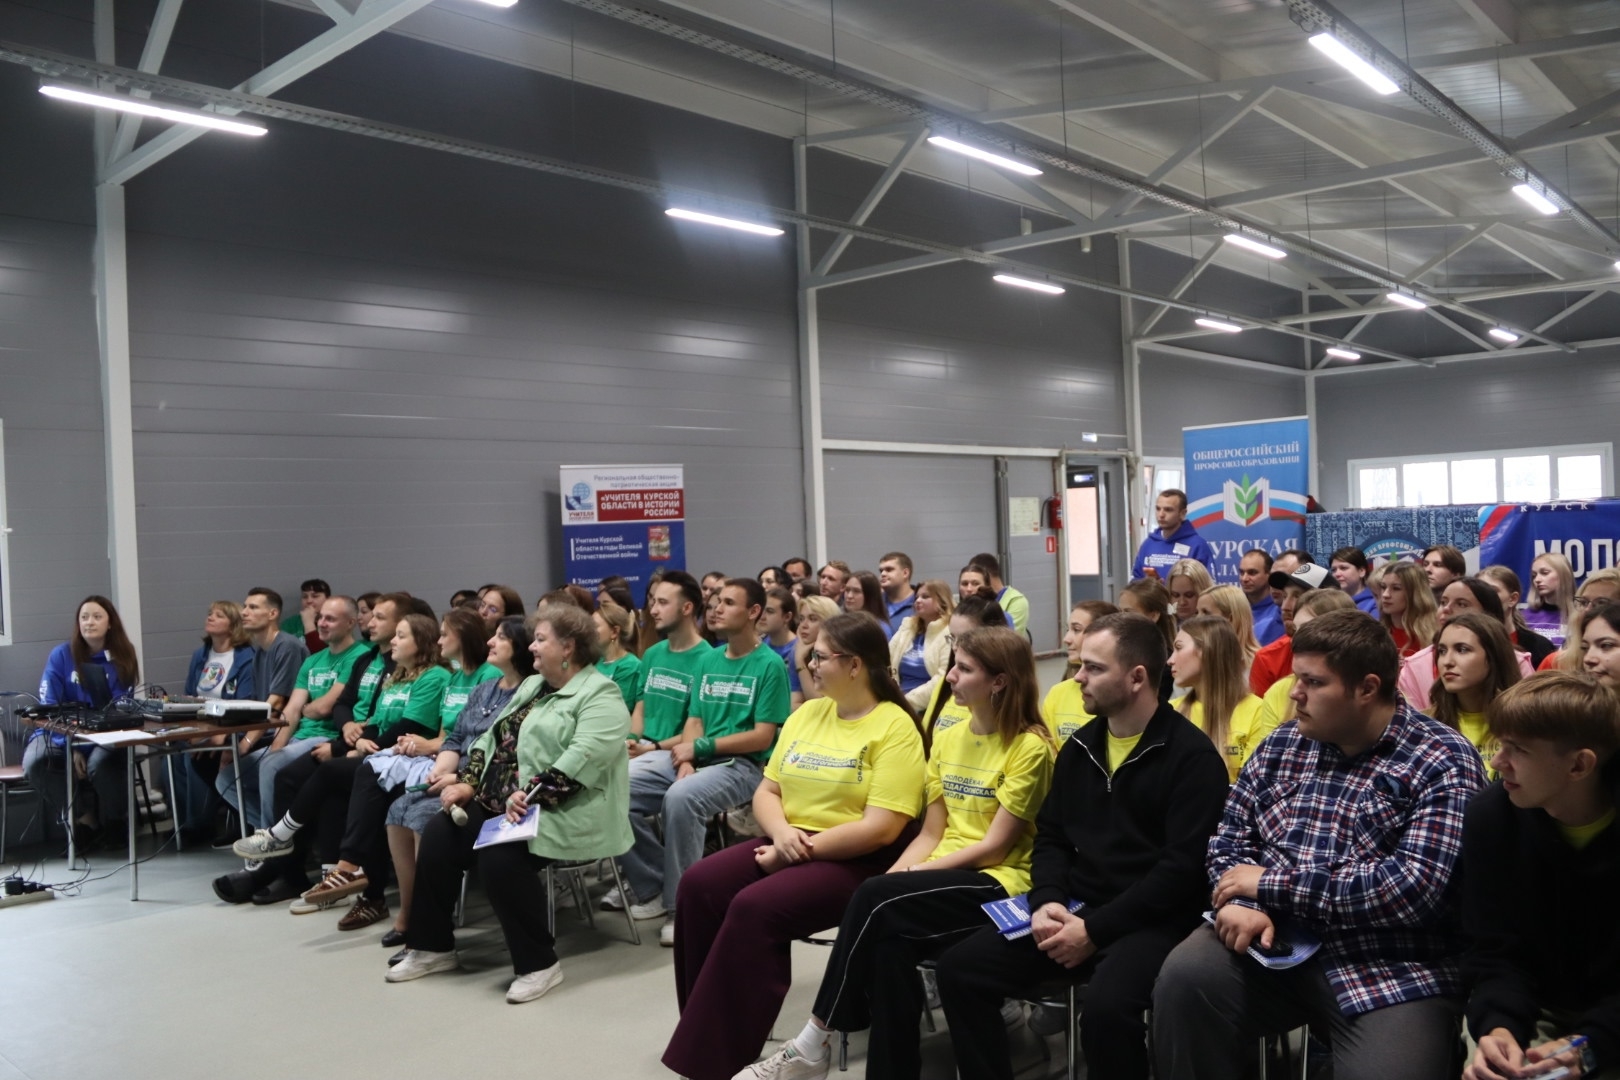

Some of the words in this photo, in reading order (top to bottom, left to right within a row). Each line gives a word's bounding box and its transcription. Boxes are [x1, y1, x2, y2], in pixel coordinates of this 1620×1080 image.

[1192, 441, 1300, 461] ОБЩЕРОССИЙСКИЙ
[1194, 460, 1241, 471] ПРОФСОЮЗ
[1241, 456, 1300, 467] ОБРАЗОВАНИЯ
[600, 493, 641, 502] «УЧИТЕЛЯ
[643, 491, 680, 500] КУРСКОЙ
[600, 501, 637, 510] ОБЛАСТИ
[638, 501, 643, 509] В
[644, 500, 680, 509] ИСТОРИИ
[643, 509, 679, 517] РОССИИ»
[1363, 520, 1386, 528] УСПЕХ
[1429, 510, 1437, 546] ОДДЕРЖКА
[599, 535, 623, 544] Курской
[1209, 538, 1299, 559] УРСКАЯ
[1534, 538, 1620, 578] ОЛ
[796, 763, 819, 771] ШКОЛА
[857, 745, 868, 782] ОБЛАСТЬ
